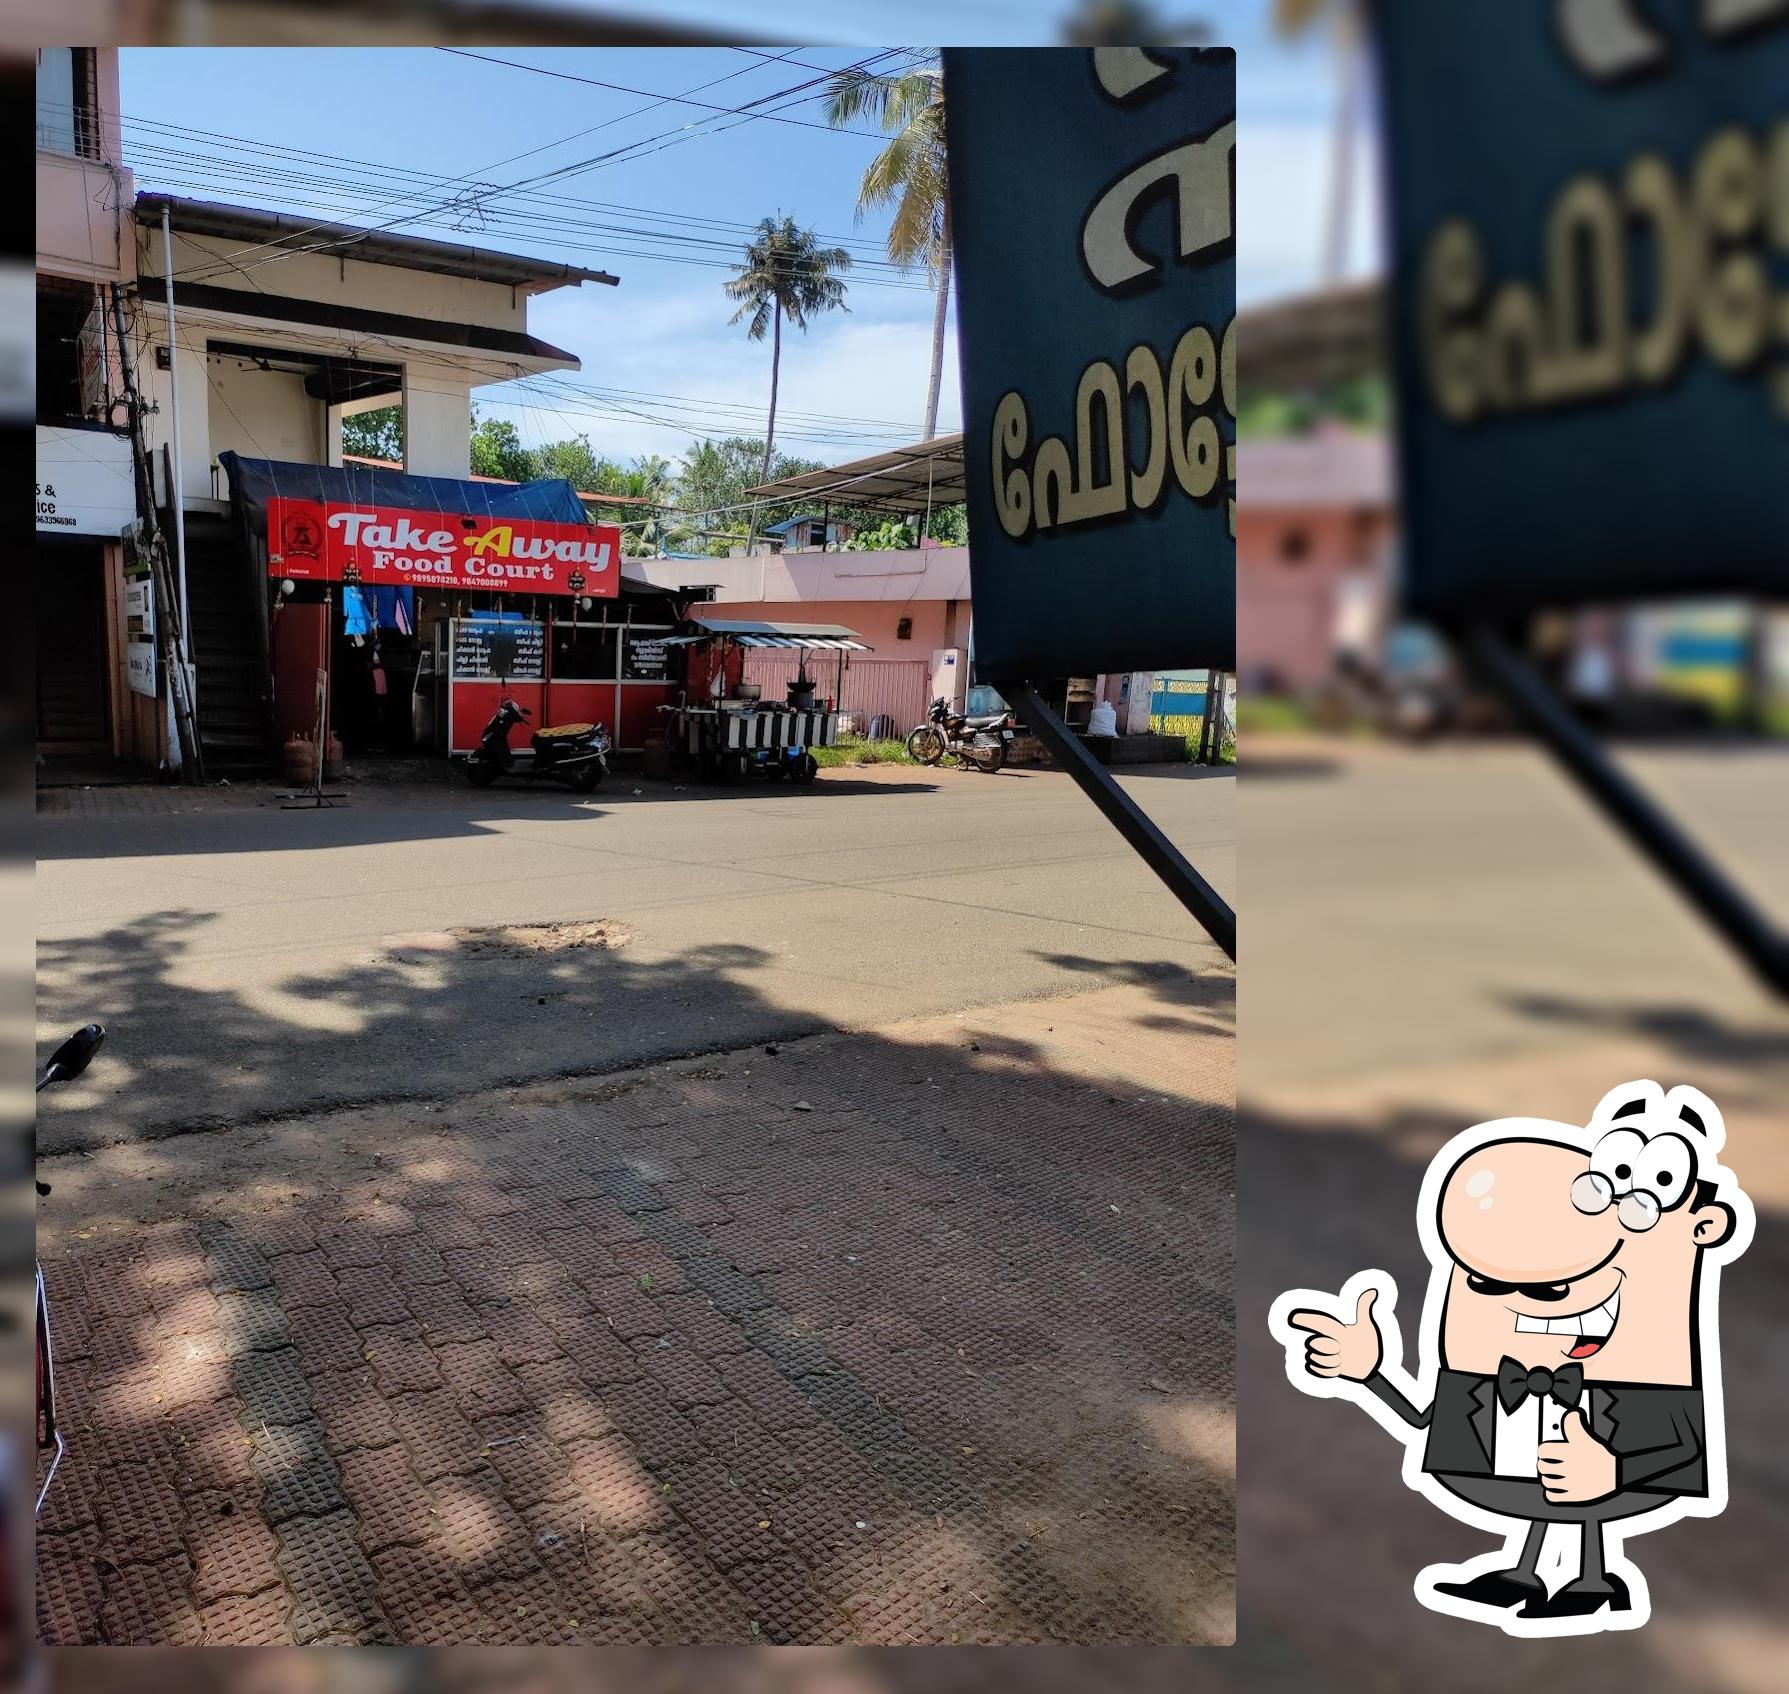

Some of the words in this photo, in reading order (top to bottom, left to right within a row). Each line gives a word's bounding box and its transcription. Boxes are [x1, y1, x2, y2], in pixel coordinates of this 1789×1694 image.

[45, 484, 56, 498] &
[328, 512, 458, 553] Take
[463, 526, 611, 572] Away
[372, 550, 454, 575] Food
[465, 557, 554, 581] Court
